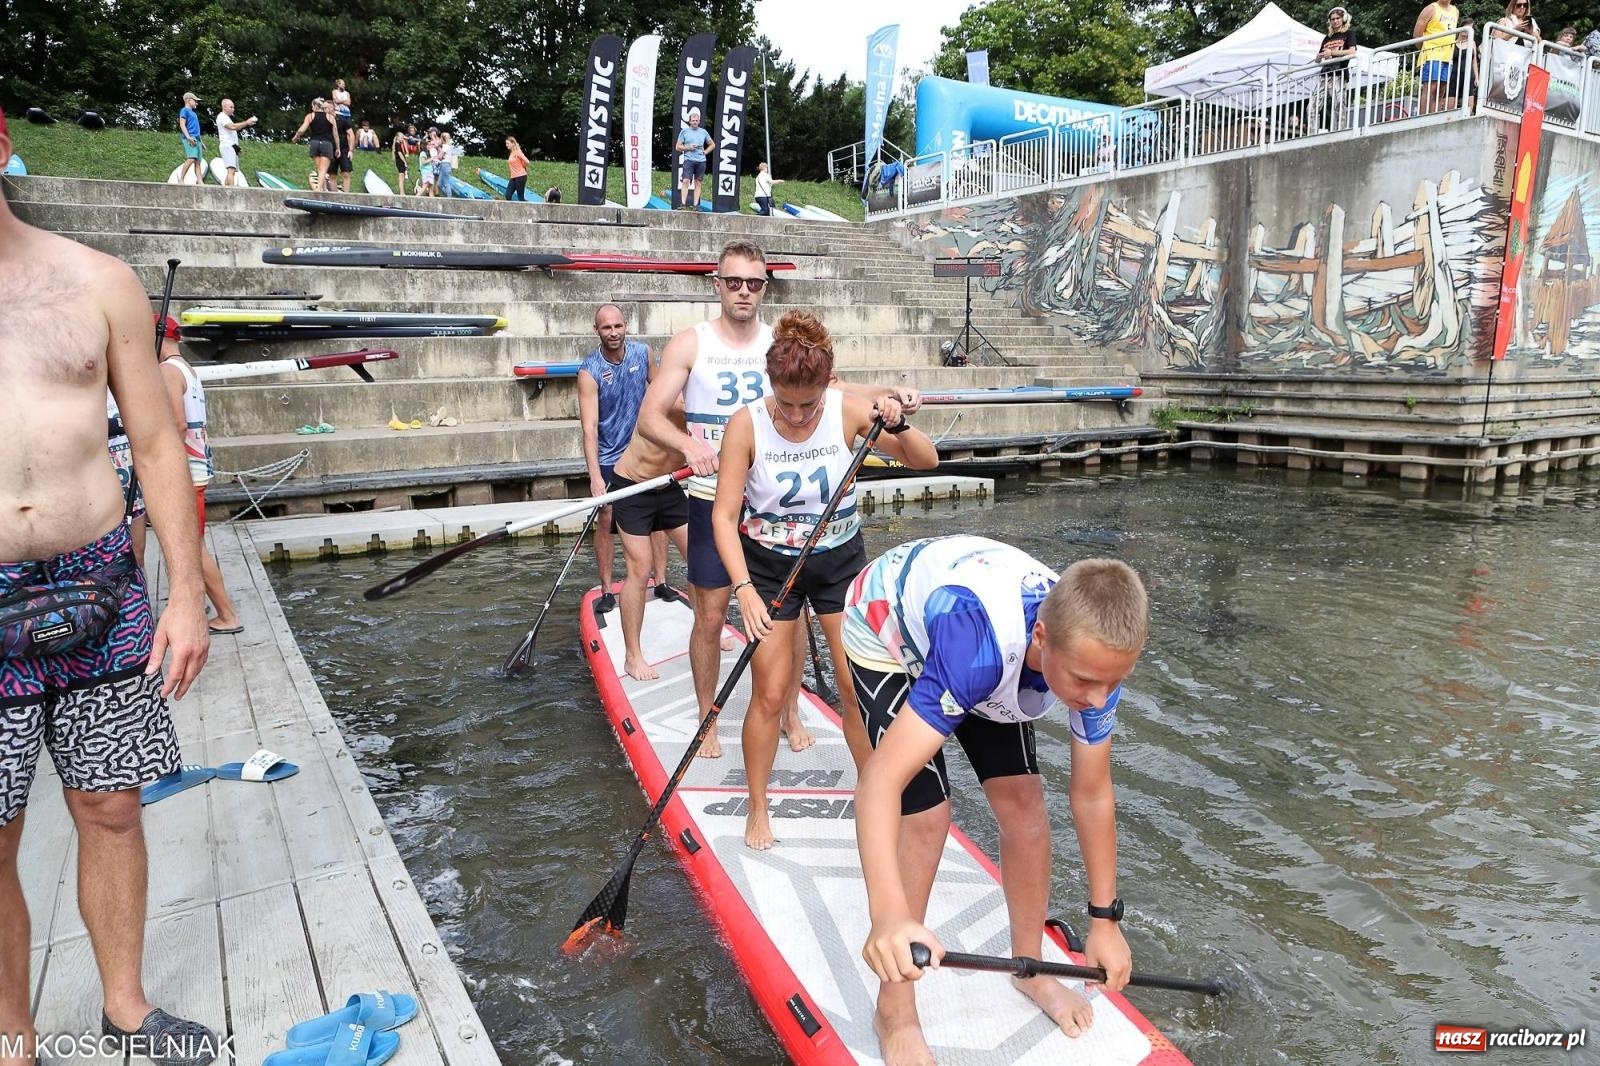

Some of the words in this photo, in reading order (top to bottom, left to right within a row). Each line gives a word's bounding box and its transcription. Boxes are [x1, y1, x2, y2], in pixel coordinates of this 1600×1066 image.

[585, 55, 615, 165] MYSTIC
[719, 67, 748, 173] MYSTIC
[871, 80, 888, 139] Marina
[296, 246, 331, 255] RAPID
[706, 354, 766, 366] #odrasupcu
[717, 371, 764, 406] 33
[764, 443, 840, 464] #odrasupcup
[775, 465, 830, 509] 21
